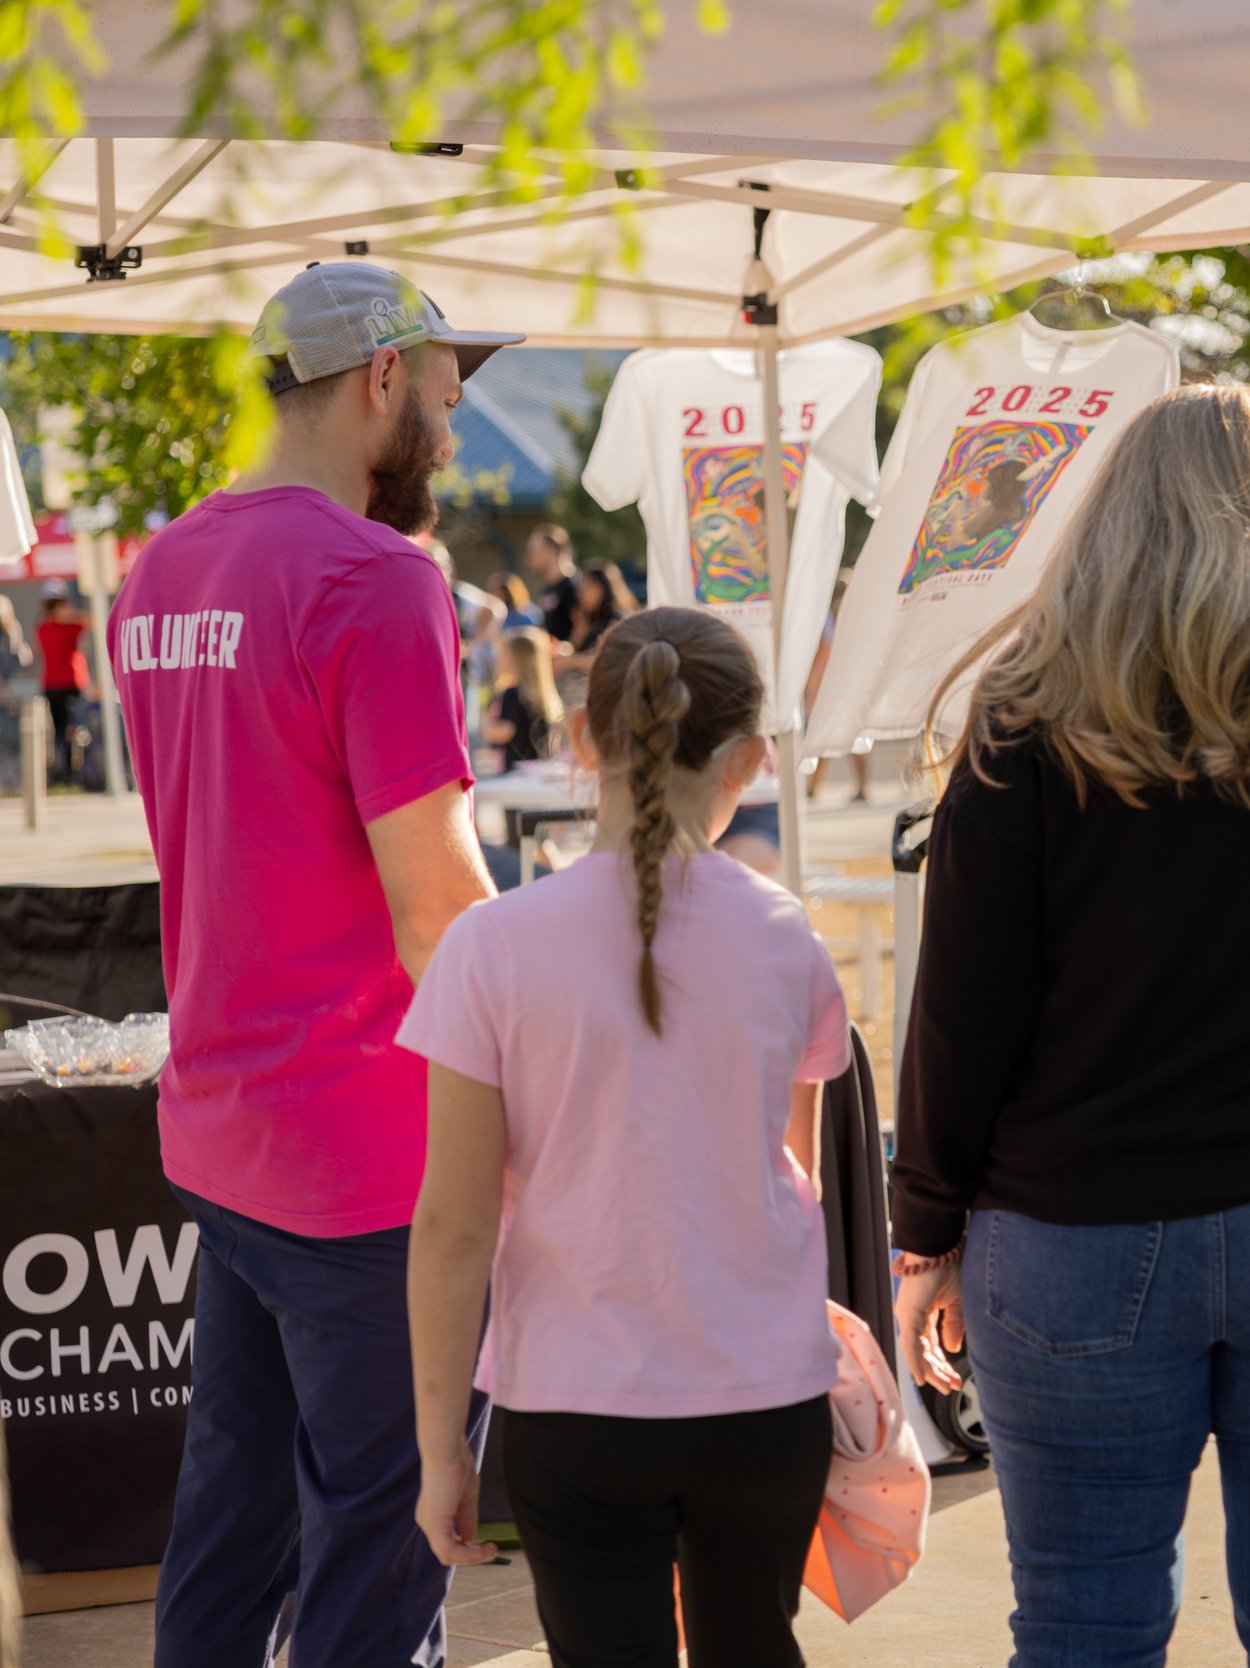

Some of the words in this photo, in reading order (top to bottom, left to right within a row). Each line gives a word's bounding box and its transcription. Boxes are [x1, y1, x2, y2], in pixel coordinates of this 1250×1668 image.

[965, 385, 1114, 418] 2025
[683, 402, 817, 437] 205
[3, 1221, 200, 1315] OW
[0, 1318, 195, 1381] CHAM
[1, 1390, 120, 1419] BUSINESS
